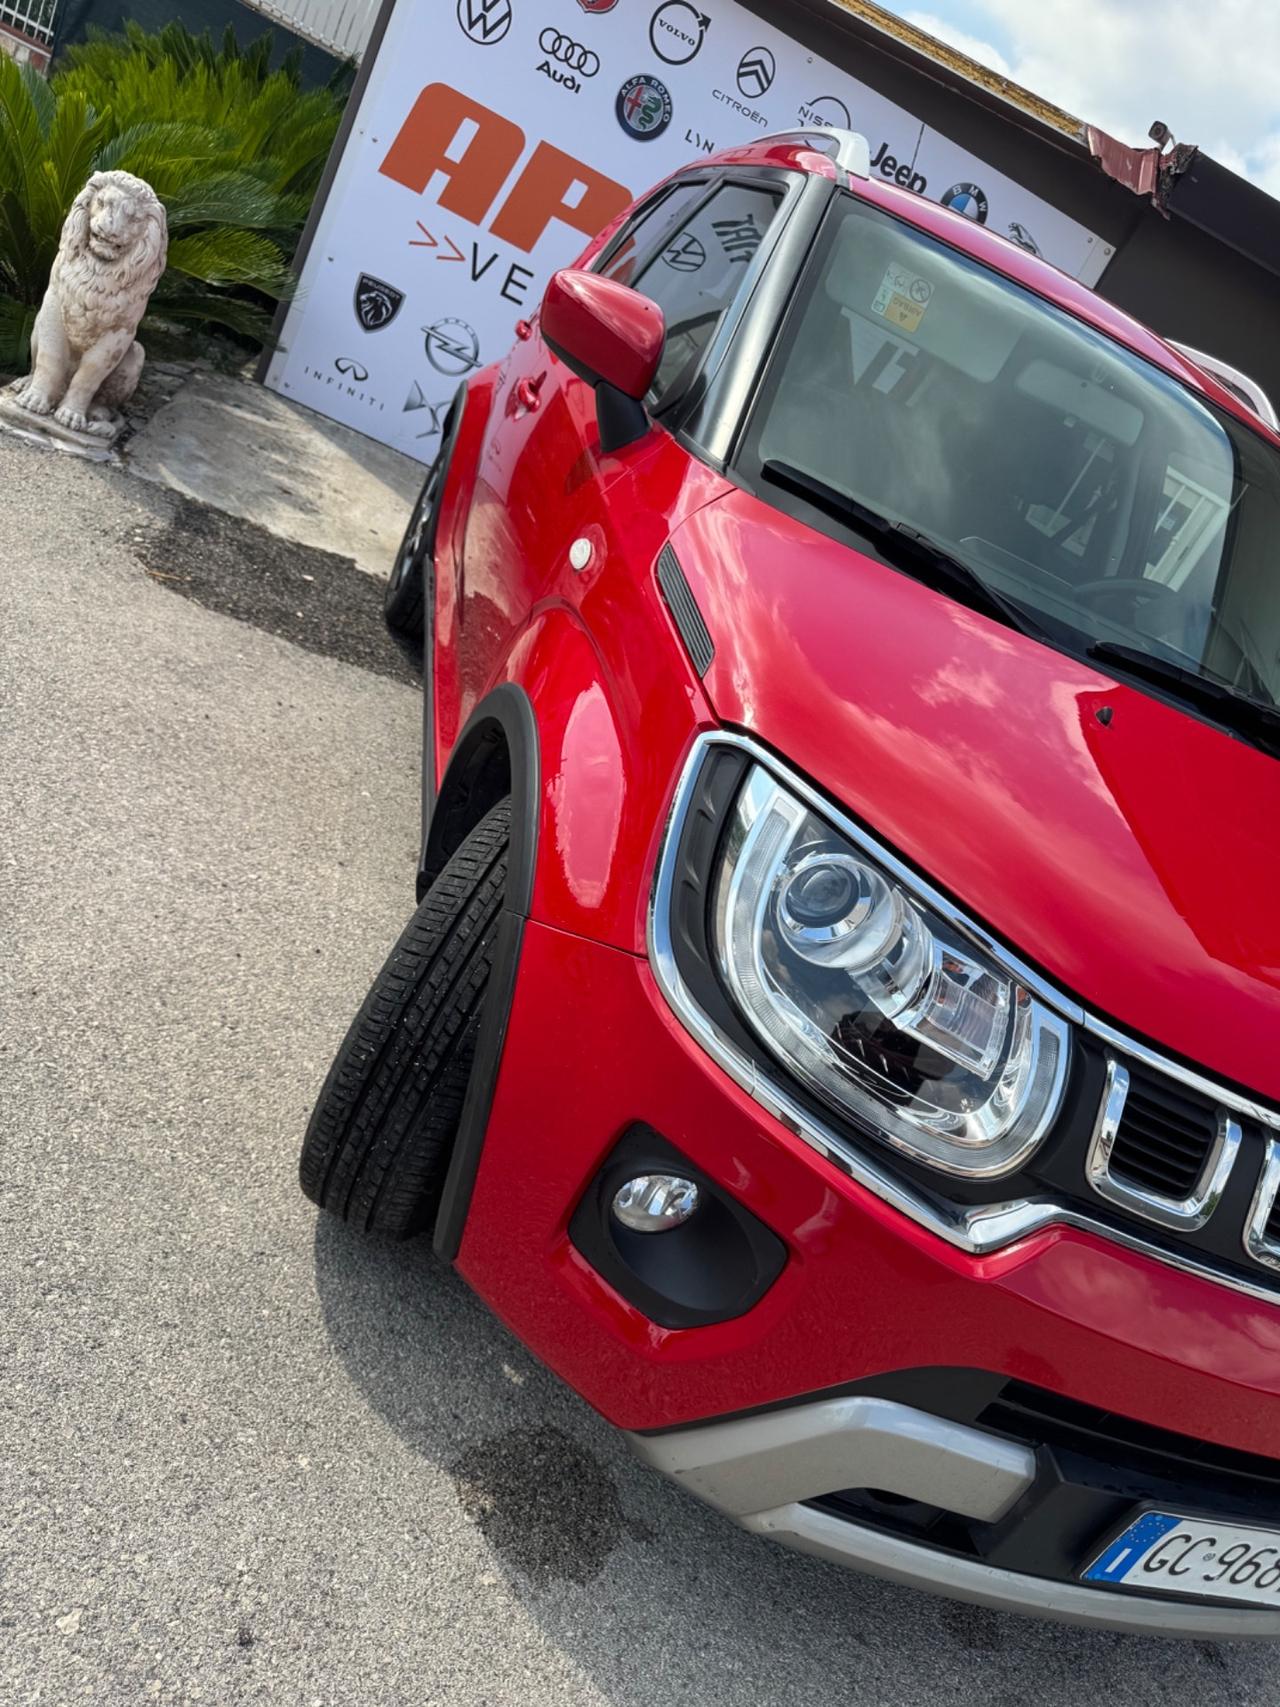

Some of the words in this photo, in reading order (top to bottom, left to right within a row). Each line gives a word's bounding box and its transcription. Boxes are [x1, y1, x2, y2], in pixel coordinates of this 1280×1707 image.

[658, 18, 696, 46] VOLVO
[535, 60, 582, 94] Audi
[621, 76, 647, 97] ALFA
[650, 79, 671, 122] ROMEO
[870, 142, 928, 194] Jeep
[952, 184, 988, 212] BMW
[304, 366, 385, 411] INFINITI
[1203, 1543, 1280, 1592] 968
